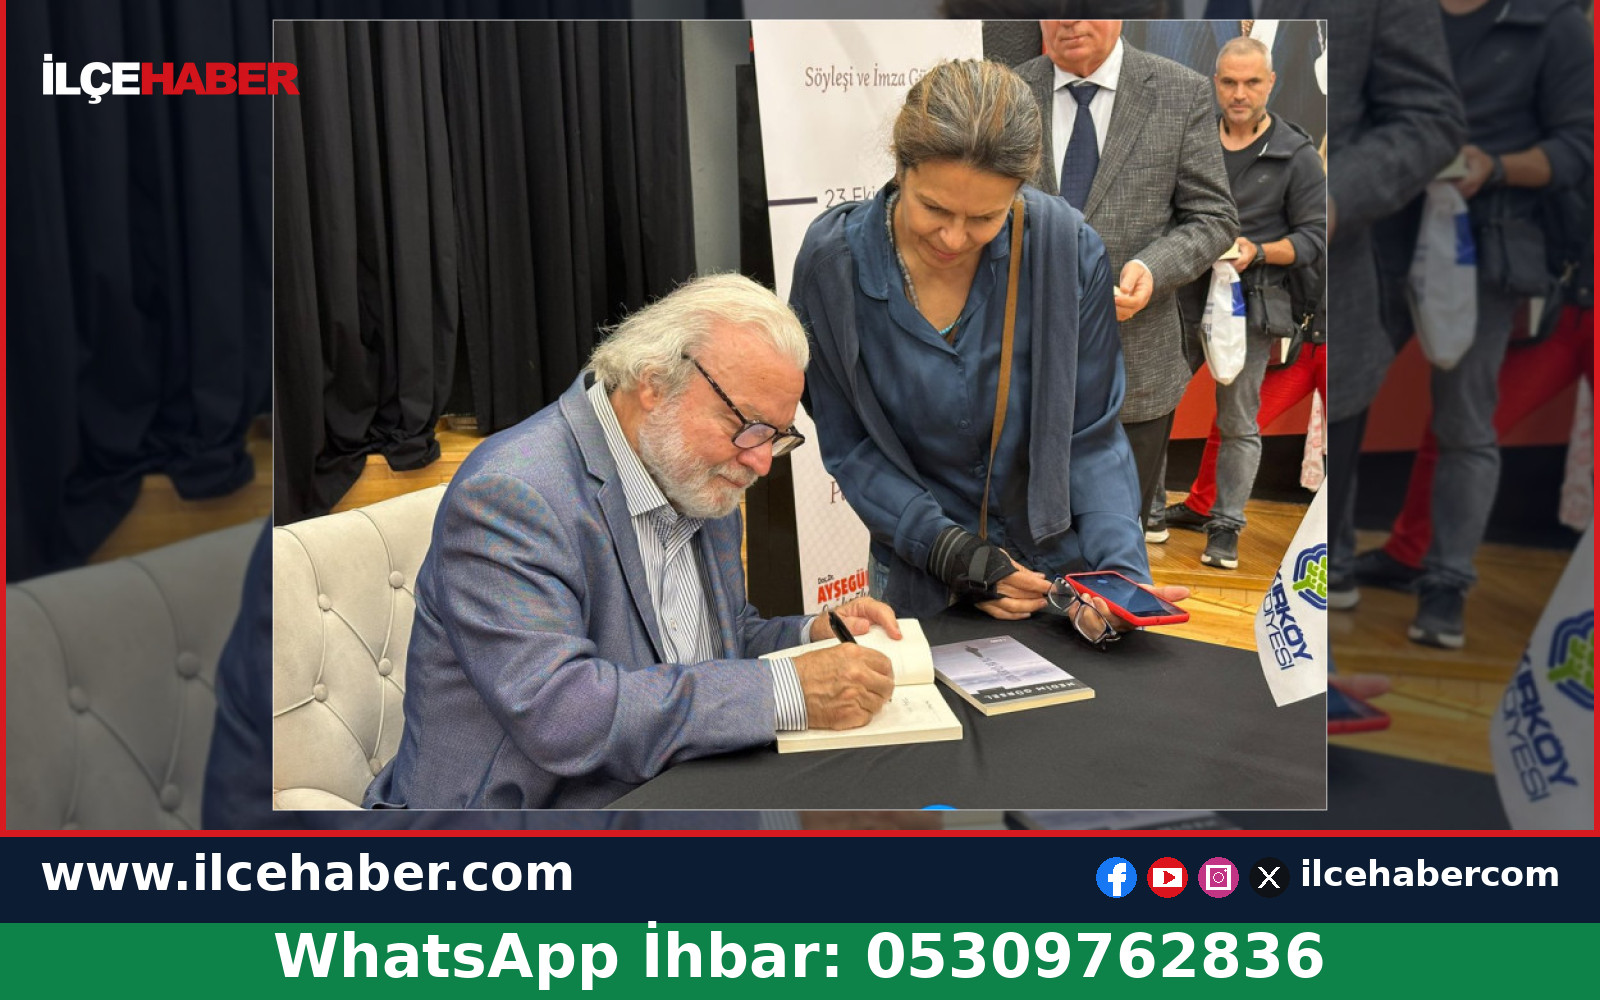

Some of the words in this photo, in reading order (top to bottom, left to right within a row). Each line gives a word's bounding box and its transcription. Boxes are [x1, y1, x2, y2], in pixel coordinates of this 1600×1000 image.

[805, 65, 854, 93] Söyleşi
[858, 72, 870, 87] ve
[873, 63, 906, 87] İmza
[825, 188, 847, 209] 23
